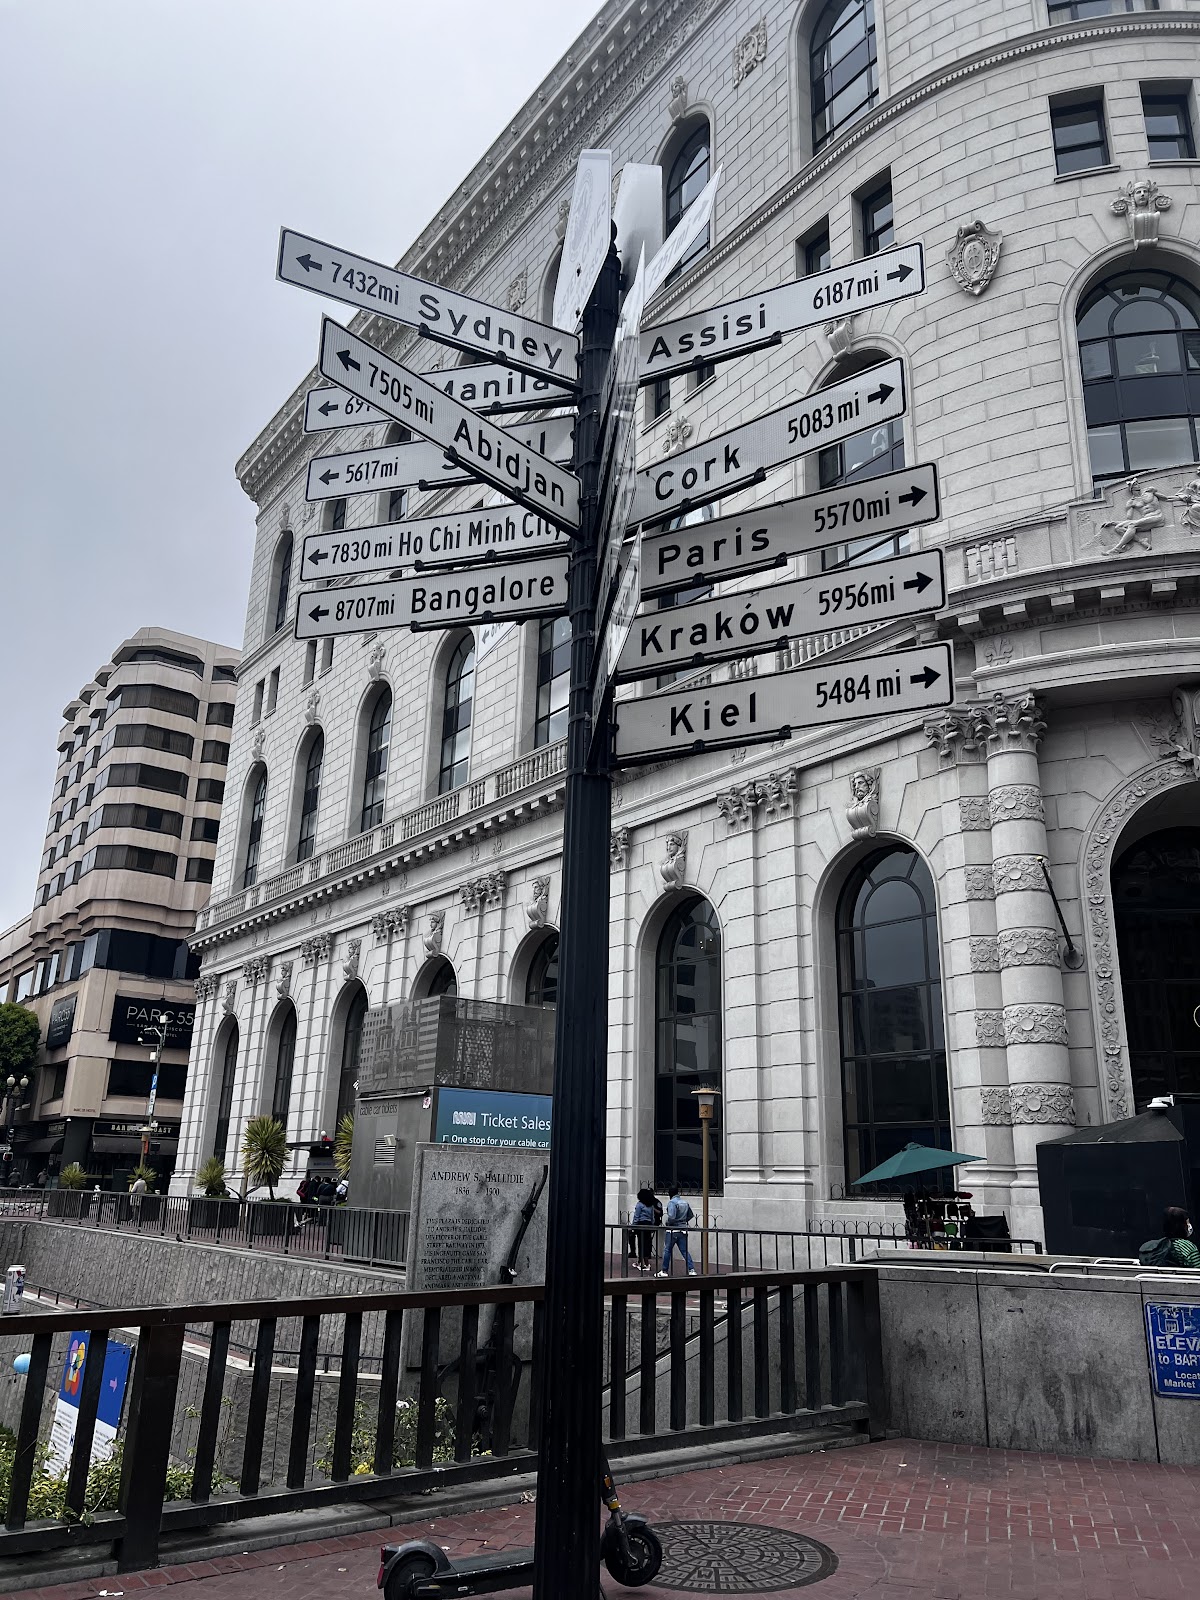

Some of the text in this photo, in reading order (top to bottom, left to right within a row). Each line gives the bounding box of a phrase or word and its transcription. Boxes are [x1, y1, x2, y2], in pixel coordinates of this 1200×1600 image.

[418, 293, 562, 369] Sydney
[646, 303, 766, 364] Assisi
[345, 457, 399, 484] 5617mi
[453, 418, 565, 507] Abidjan
[655, 444, 740, 501] Cork
[399, 532, 423, 557] Ho
[430, 527, 461, 552] Chi
[469, 515, 515, 546] Minh
[658, 526, 769, 575] Paris
[411, 575, 555, 614] Bangalore
[641, 602, 794, 656] Kraków
[819, 576, 895, 616] 5956mi
[670, 692, 756, 737] Kiel
[127, 1006, 194, 1025] PARC 55
[451, 1134, 468, 1144] One
[469, 1136, 486, 1146] stop
[487, 1136, 498, 1145] for
[500, 1139, 516, 1148] your
[518, 1138, 536, 1148] cable
[481, 1113, 518, 1129] Ticket
[521, 1116, 551, 1131] Sales
[430, 1171, 470, 1182] ANDREW
[1158, 1353, 1170, 1364] to
[1164, 1378, 1196, 1389] Market
